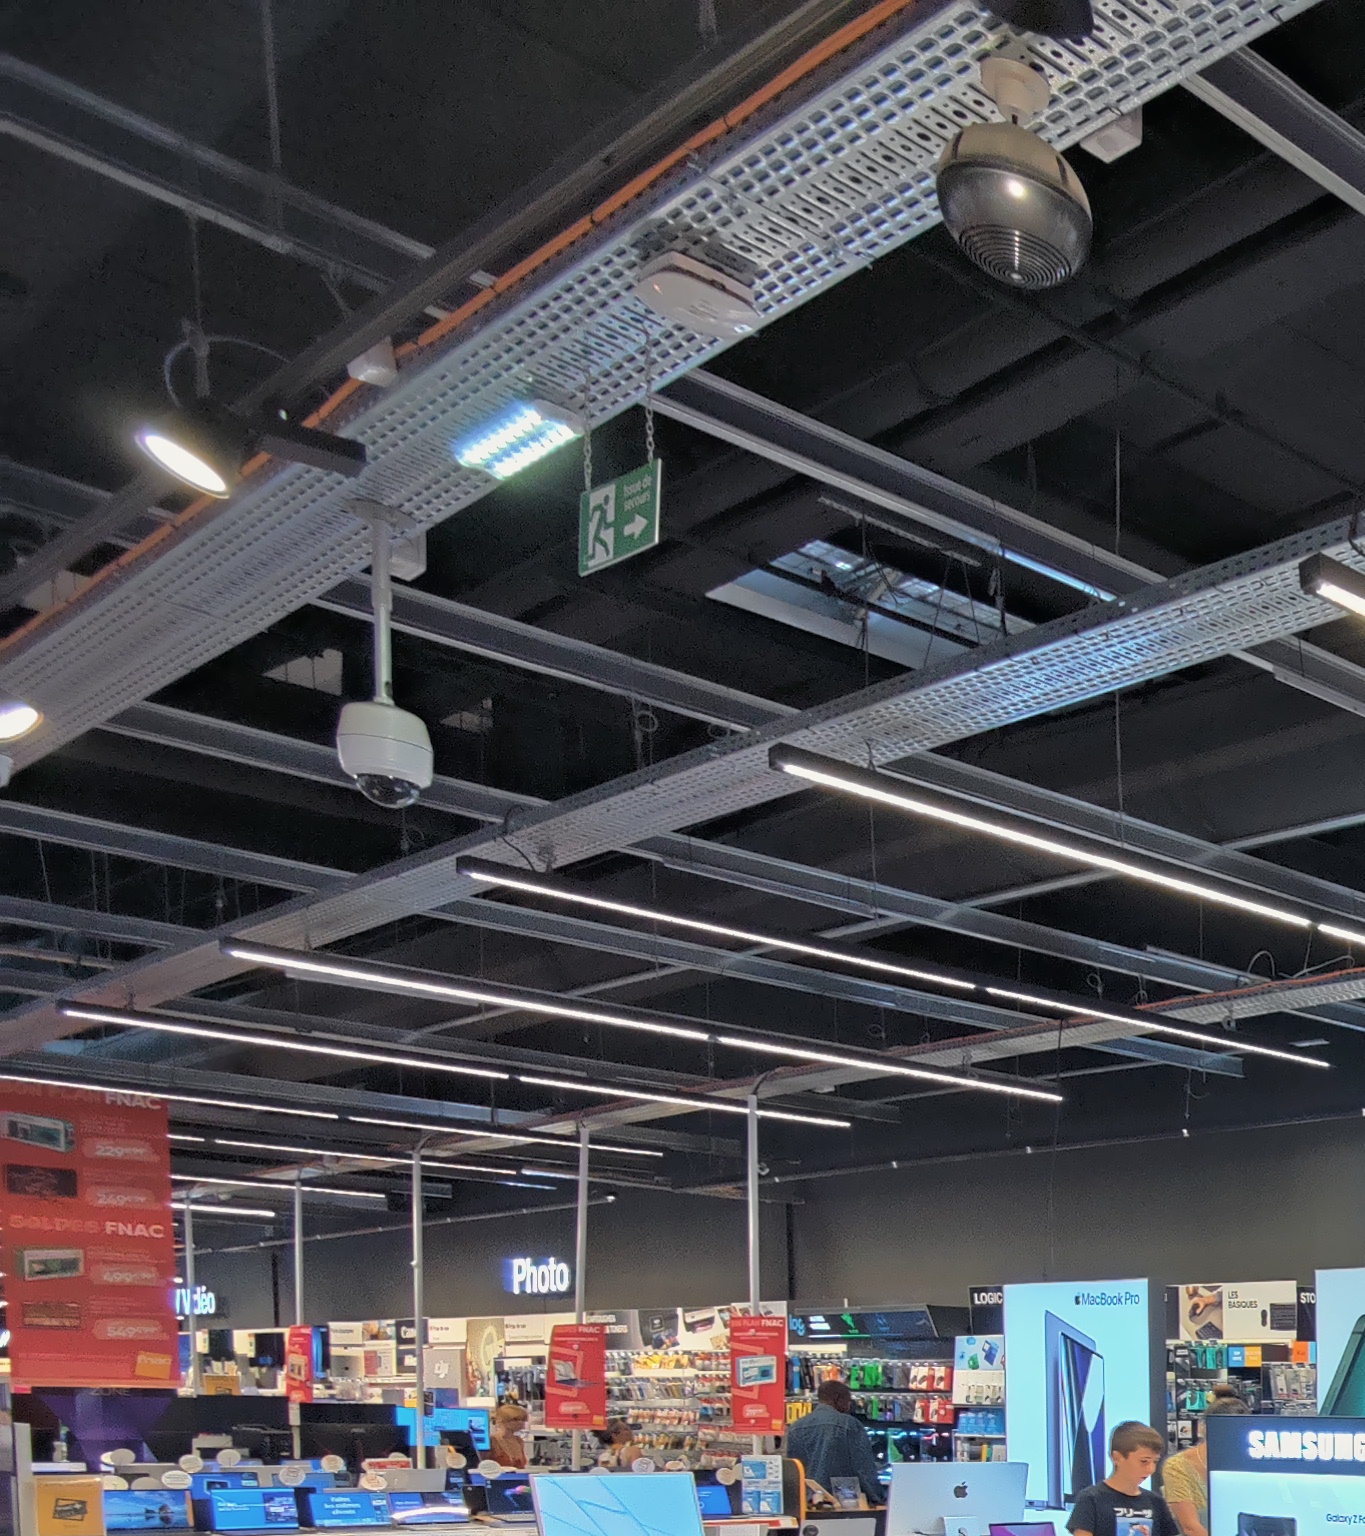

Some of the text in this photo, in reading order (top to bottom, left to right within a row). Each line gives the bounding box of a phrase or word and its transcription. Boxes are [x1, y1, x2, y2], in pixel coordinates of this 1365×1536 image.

[105, 1221, 164, 1238] FNAC
[513, 1257, 569, 1294] Photo
[1081, 1291, 1140, 1306] MacBook Pro
[1228, 1291, 1238, 1299] LES
[1326, 1513, 1351, 1525] Galaxy
